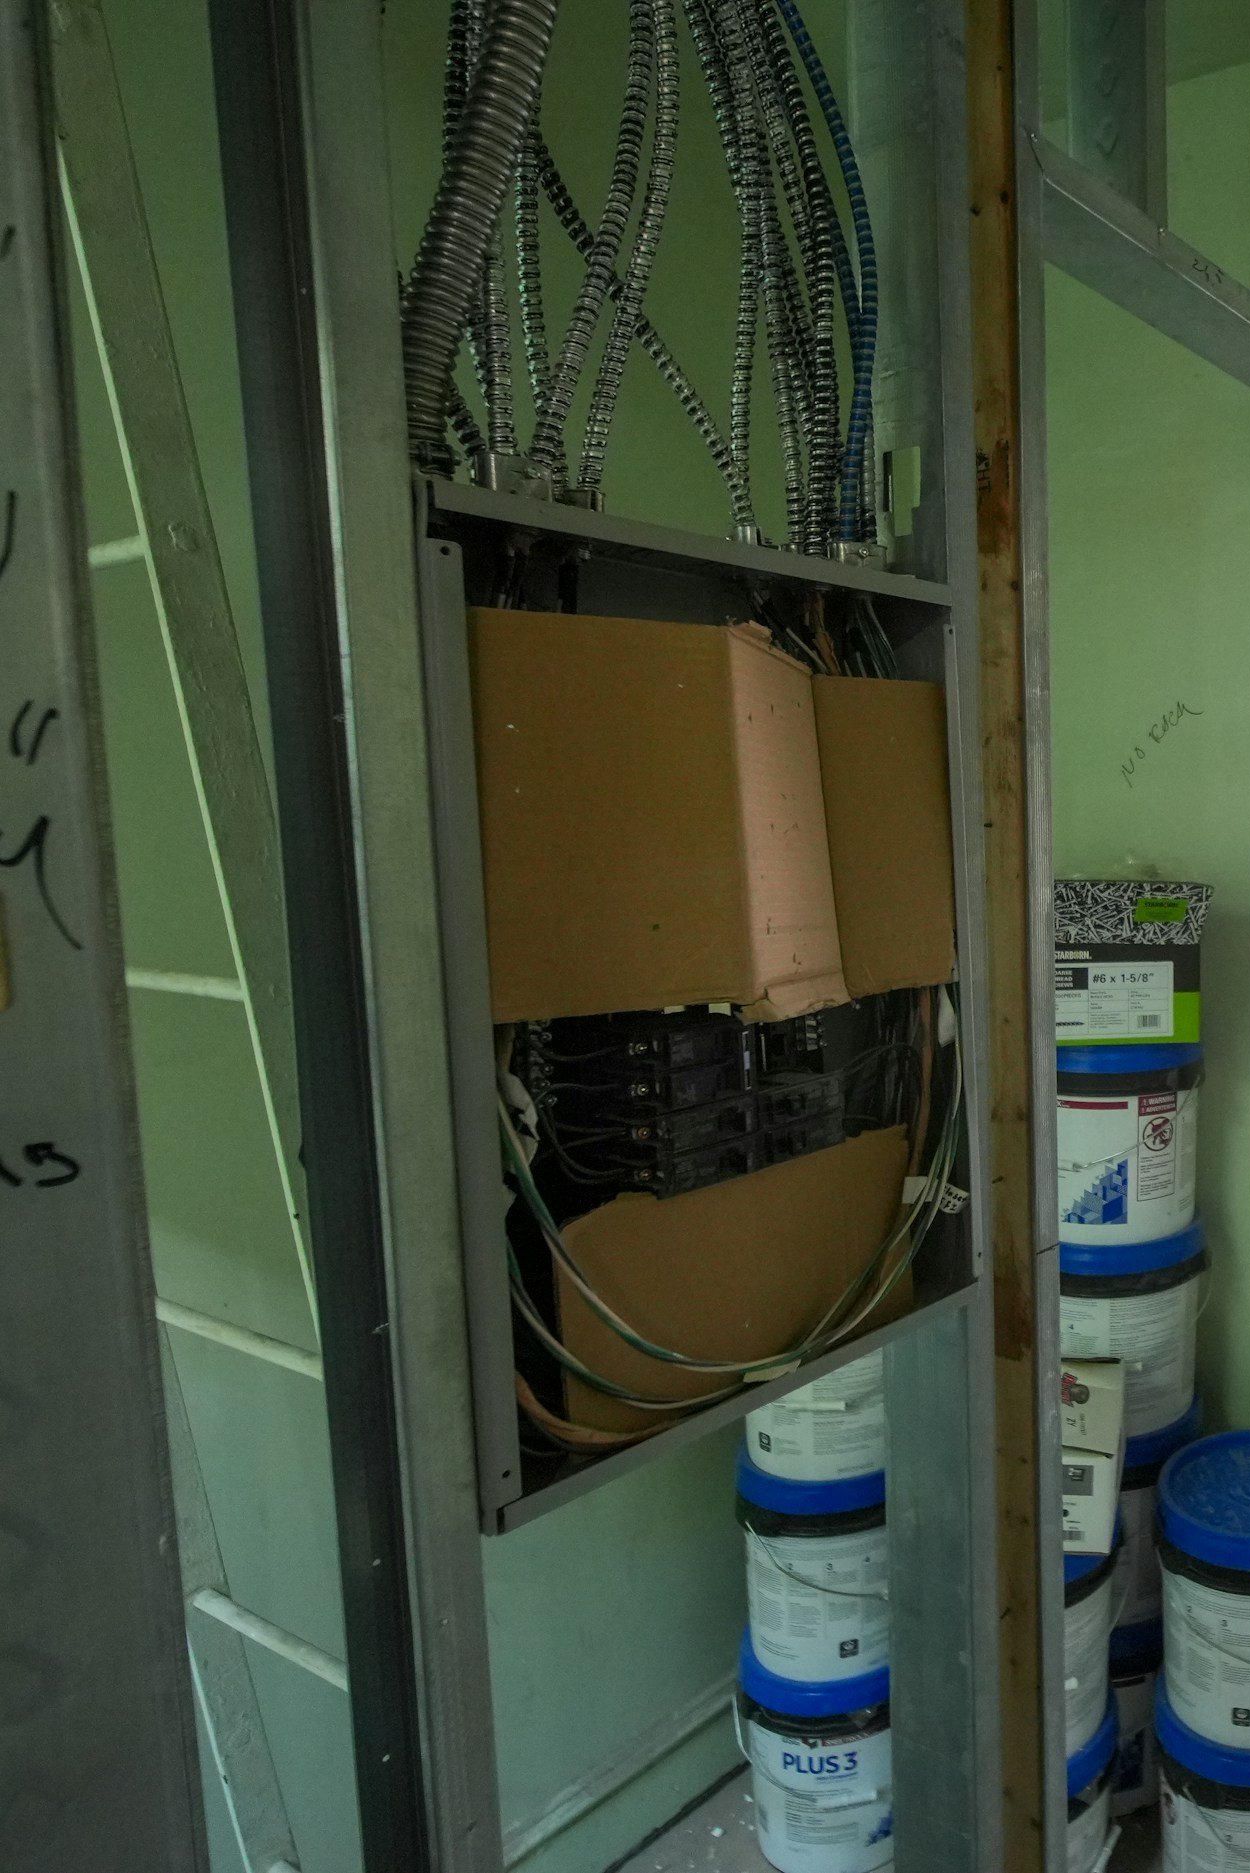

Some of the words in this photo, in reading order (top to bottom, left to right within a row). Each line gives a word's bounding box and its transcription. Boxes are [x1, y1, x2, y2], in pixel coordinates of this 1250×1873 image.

[1092, 973, 1107, 983] #6
[1121, 973, 1154, 983] 1-5/8"
[1148, 1094, 1175, 1105] WARNING
[783, 1752, 840, 1775] PLUS
[843, 1752, 858, 1771] 3
